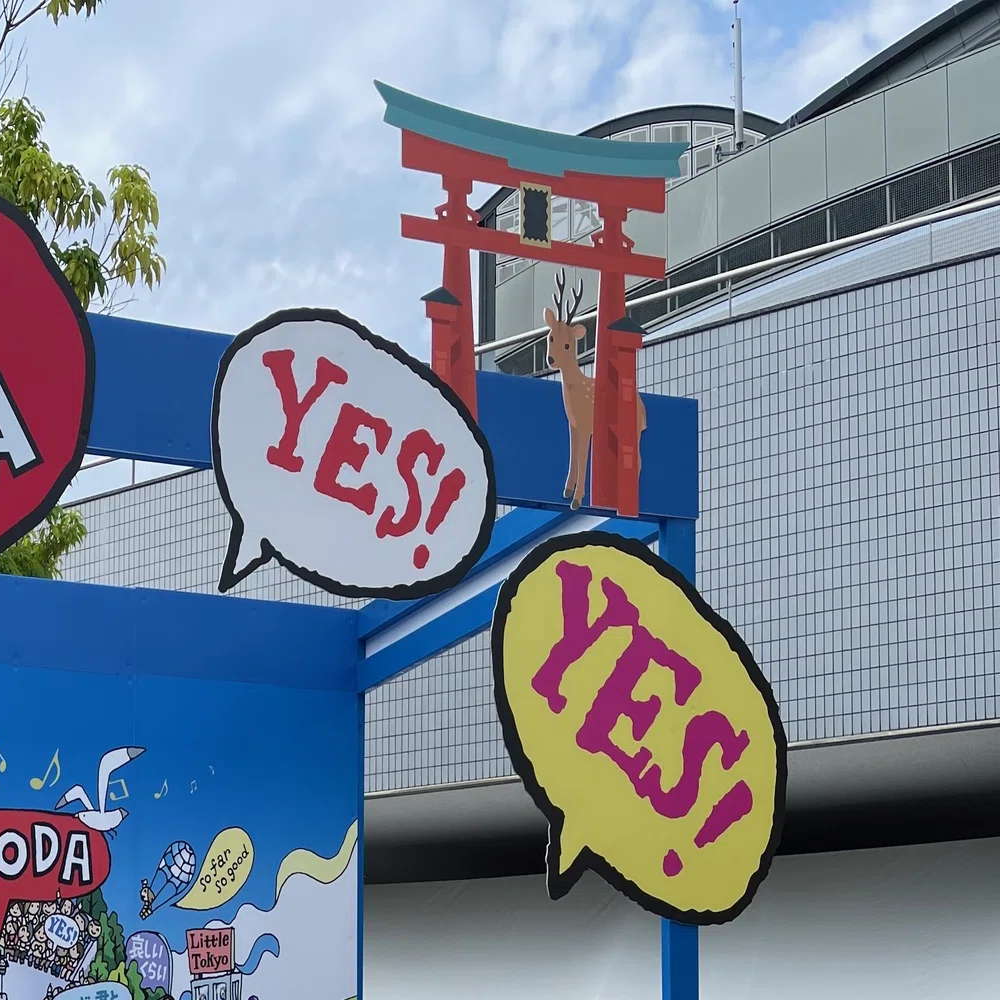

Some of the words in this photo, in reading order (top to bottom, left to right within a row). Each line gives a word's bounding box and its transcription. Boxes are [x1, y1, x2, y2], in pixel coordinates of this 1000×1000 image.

[262, 349, 466, 569] YES!
[531, 560, 753, 876] YES!
[200, 874, 211, 892] so
[210, 849, 231, 877] far
[215, 877, 227, 894] so
[227, 844, 249, 882] good
[48, 917, 77, 946] YES!
[190, 930, 229, 949] Little
[129, 935, 163, 959] 哀しい
[191, 952, 228, 970] Tokyo
[140, 961, 167, 982] くらい
